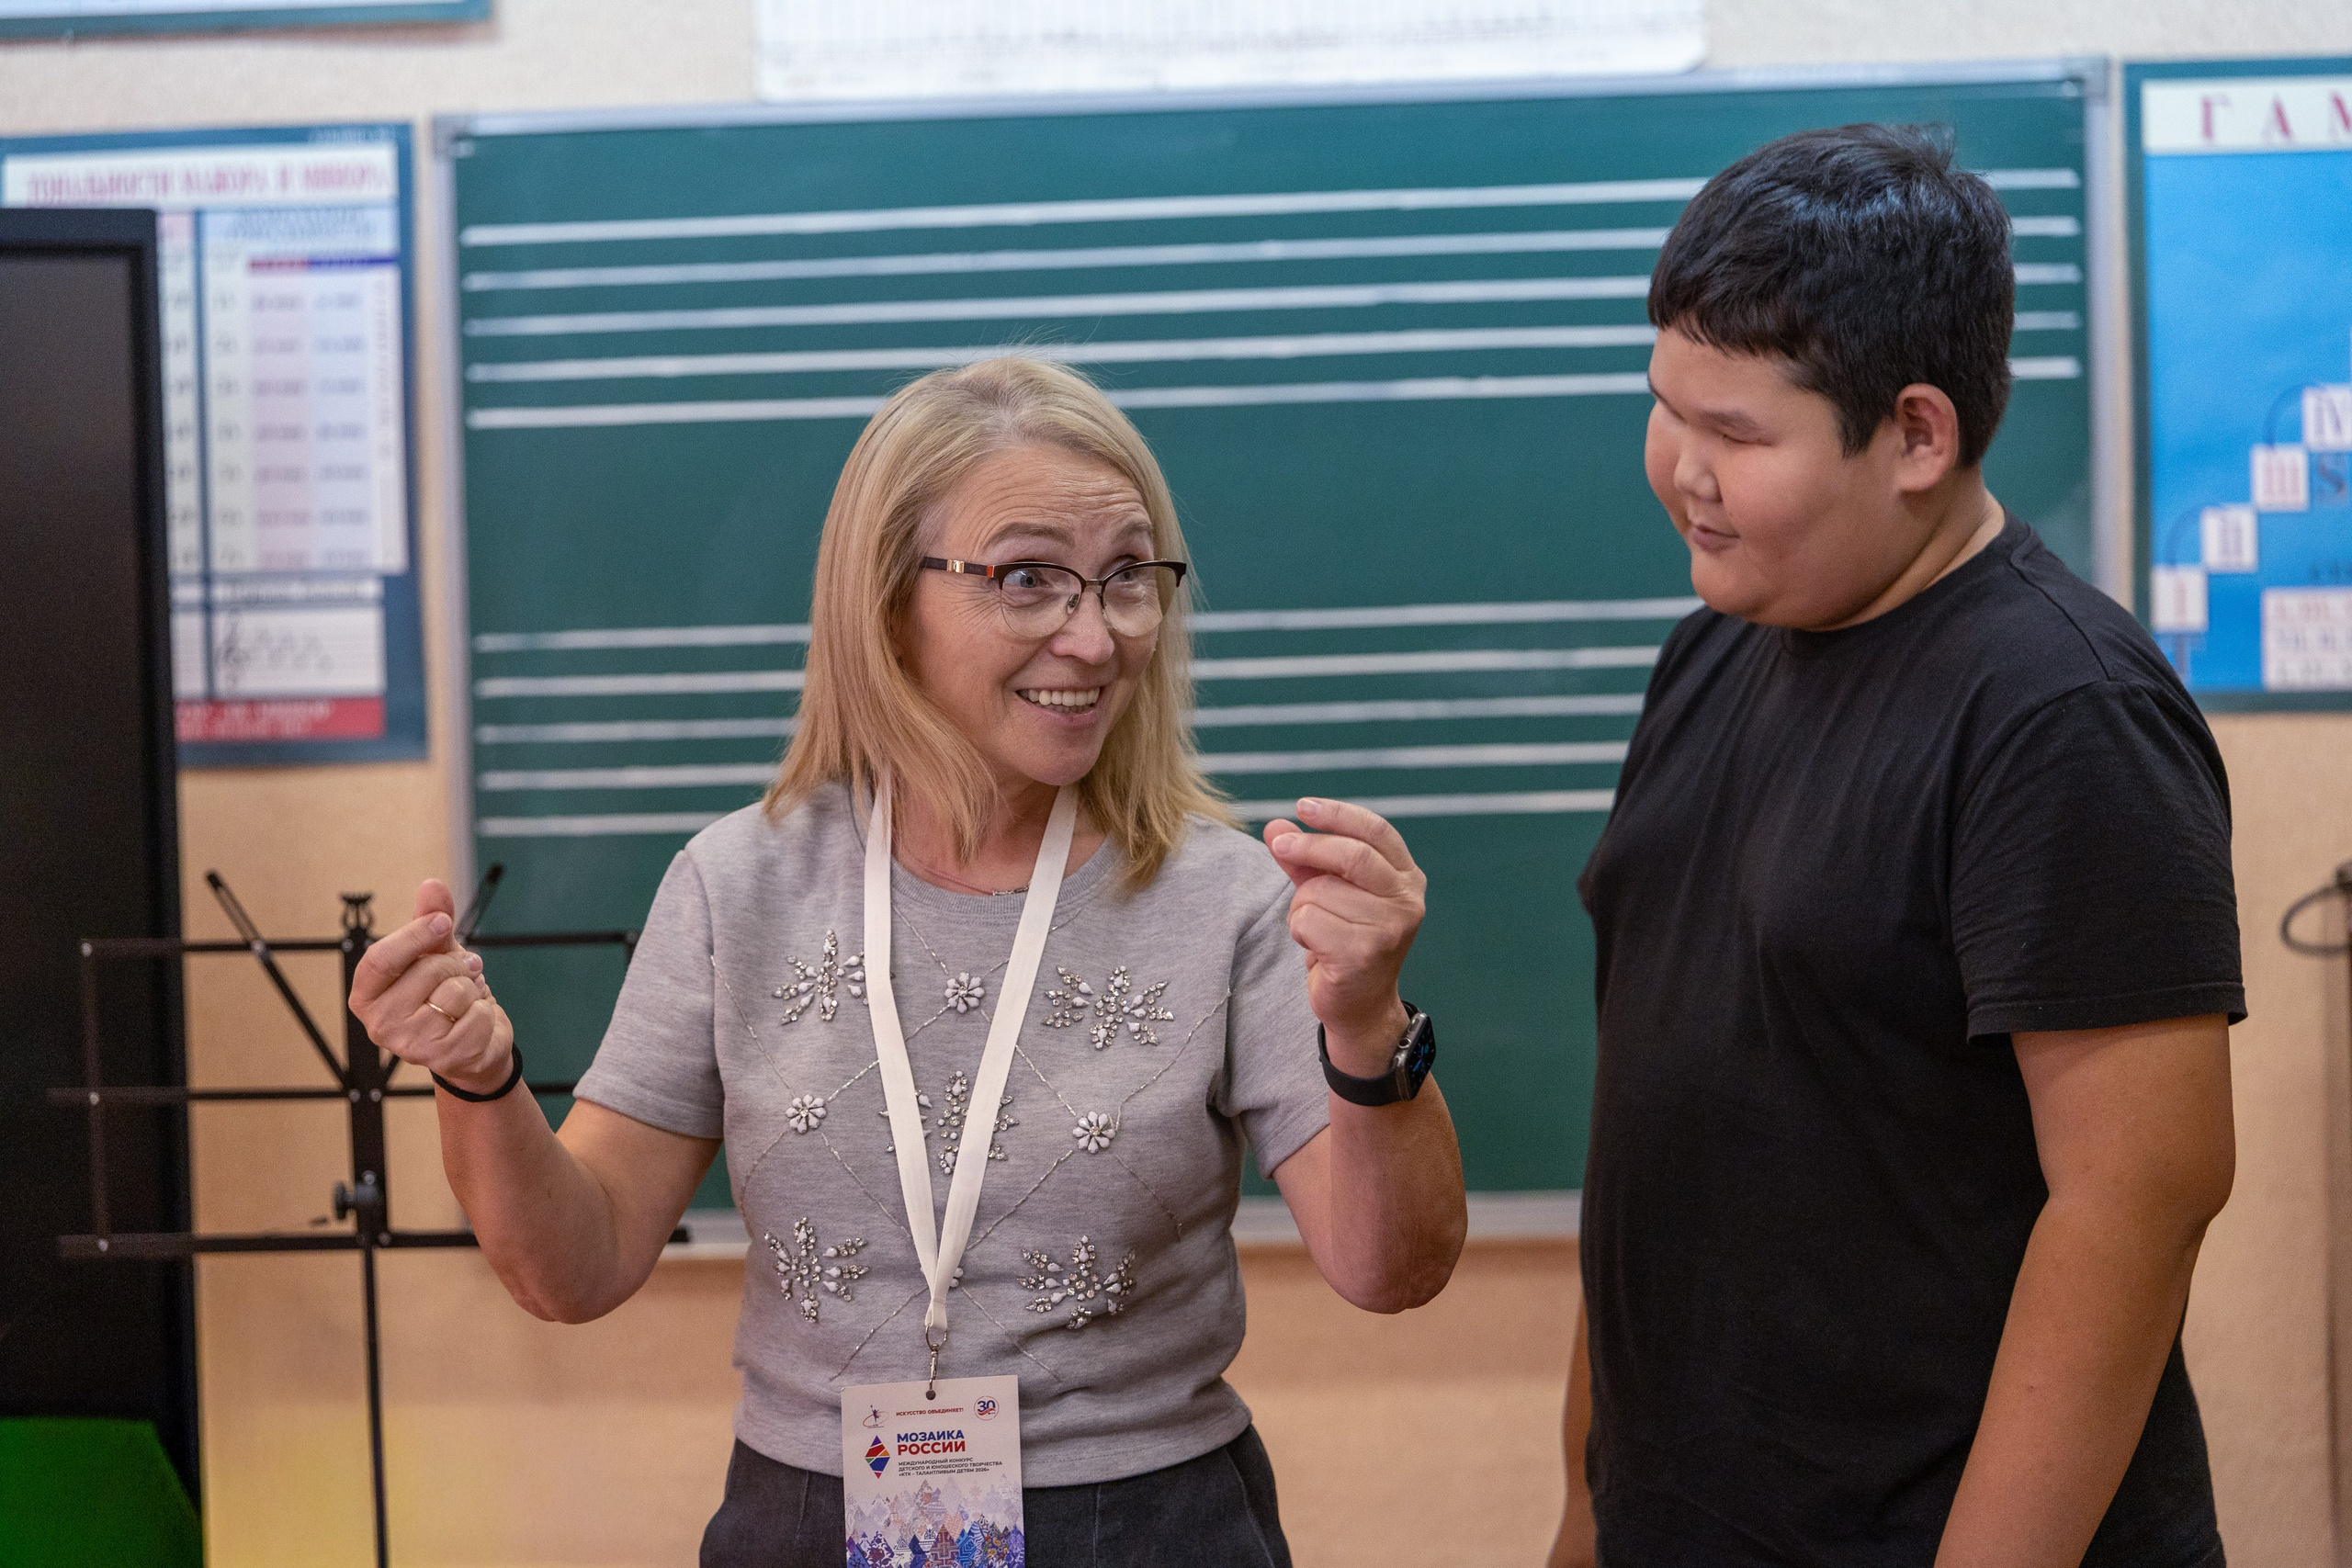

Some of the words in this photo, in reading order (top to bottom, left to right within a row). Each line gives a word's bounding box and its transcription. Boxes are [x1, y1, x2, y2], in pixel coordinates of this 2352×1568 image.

[897, 1429, 965, 1443] МОЗАИКА
[897, 1440, 966, 1456] РОССИИ
[899, 1458, 948, 1466] МЕЖДУНАРОДНЫЙ
